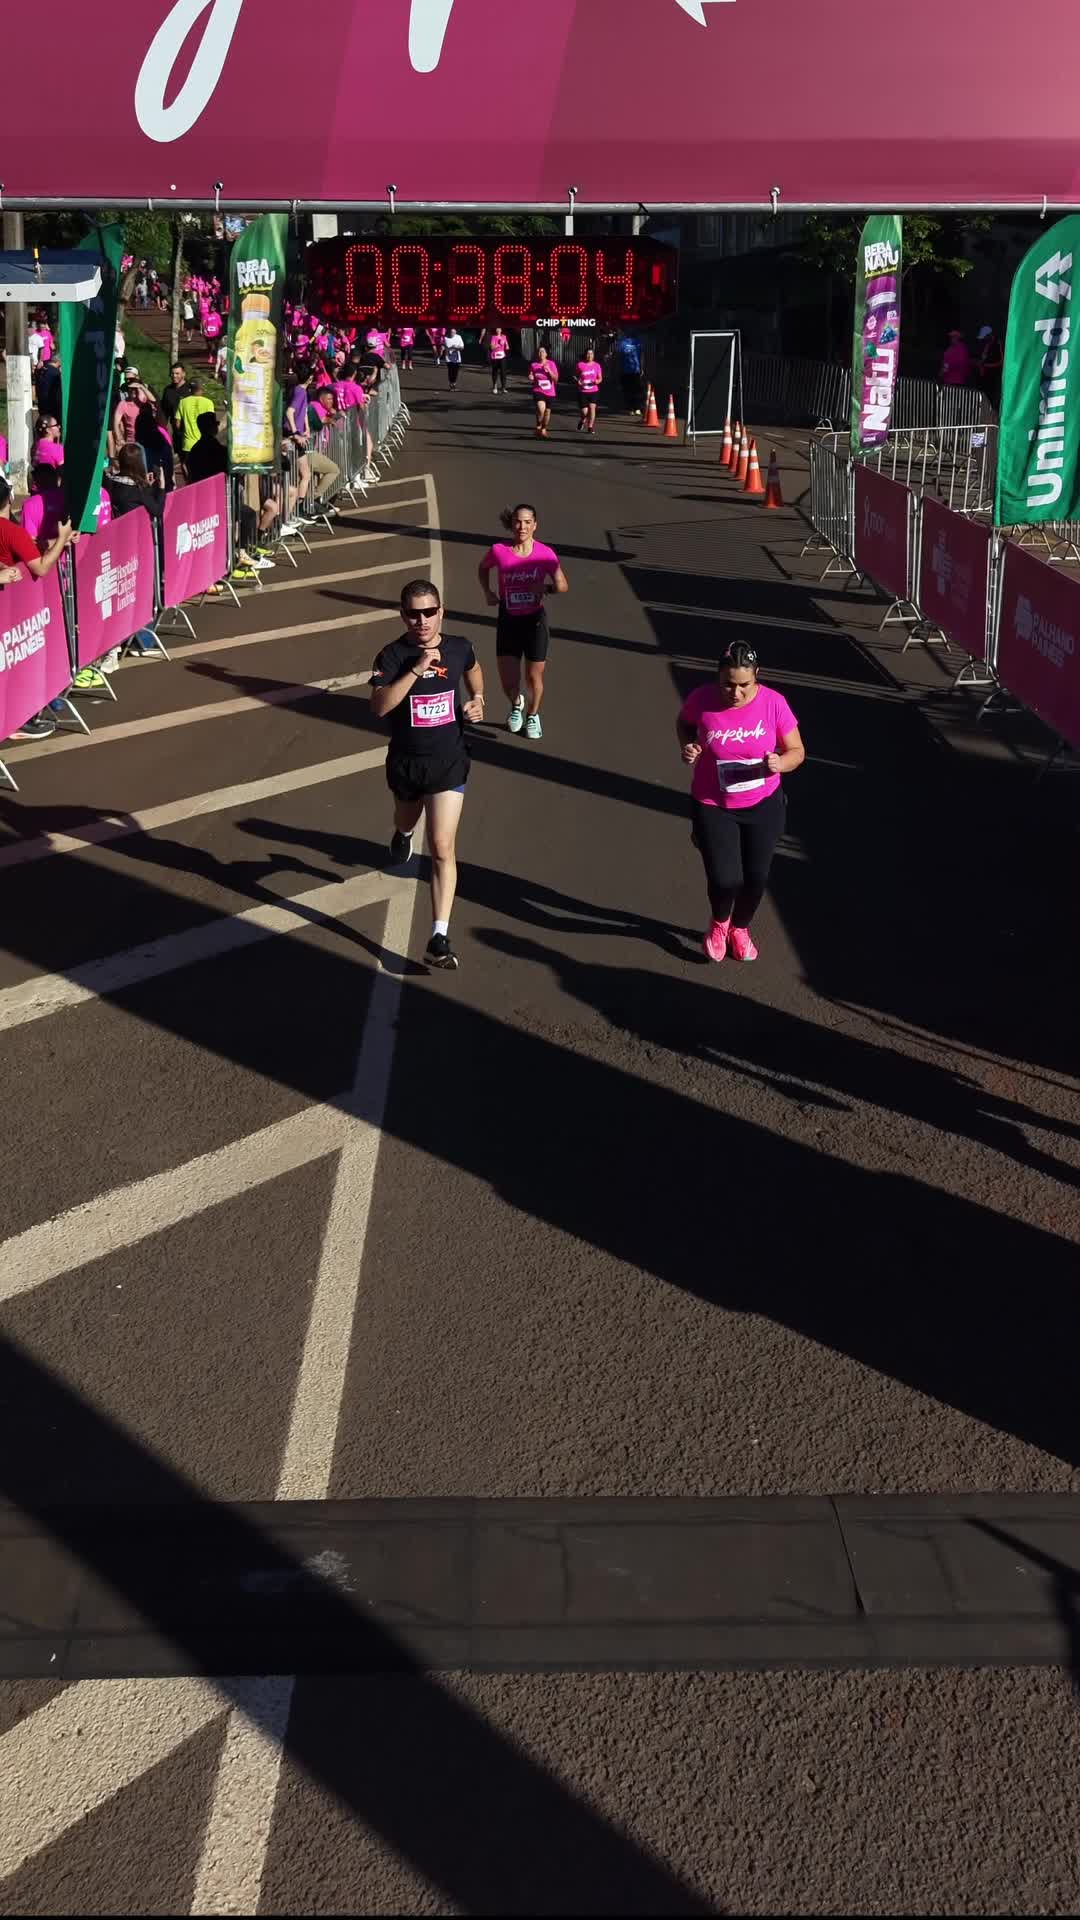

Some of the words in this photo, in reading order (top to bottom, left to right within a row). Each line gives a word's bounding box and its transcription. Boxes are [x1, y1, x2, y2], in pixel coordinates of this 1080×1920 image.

[864, 240, 891, 258] BEBA
[236, 258, 269, 274] BEBA
[864, 250, 899, 273] NATU
[237, 270, 276, 288] NATU
[345, 245, 634, 315] 00:38:04
[1027, 317, 1071, 508] Unimed
[189, 514, 220, 537] PALHANO
[2, 607, 51, 651] PALHANO
[422, 703, 446, 715] 1722
